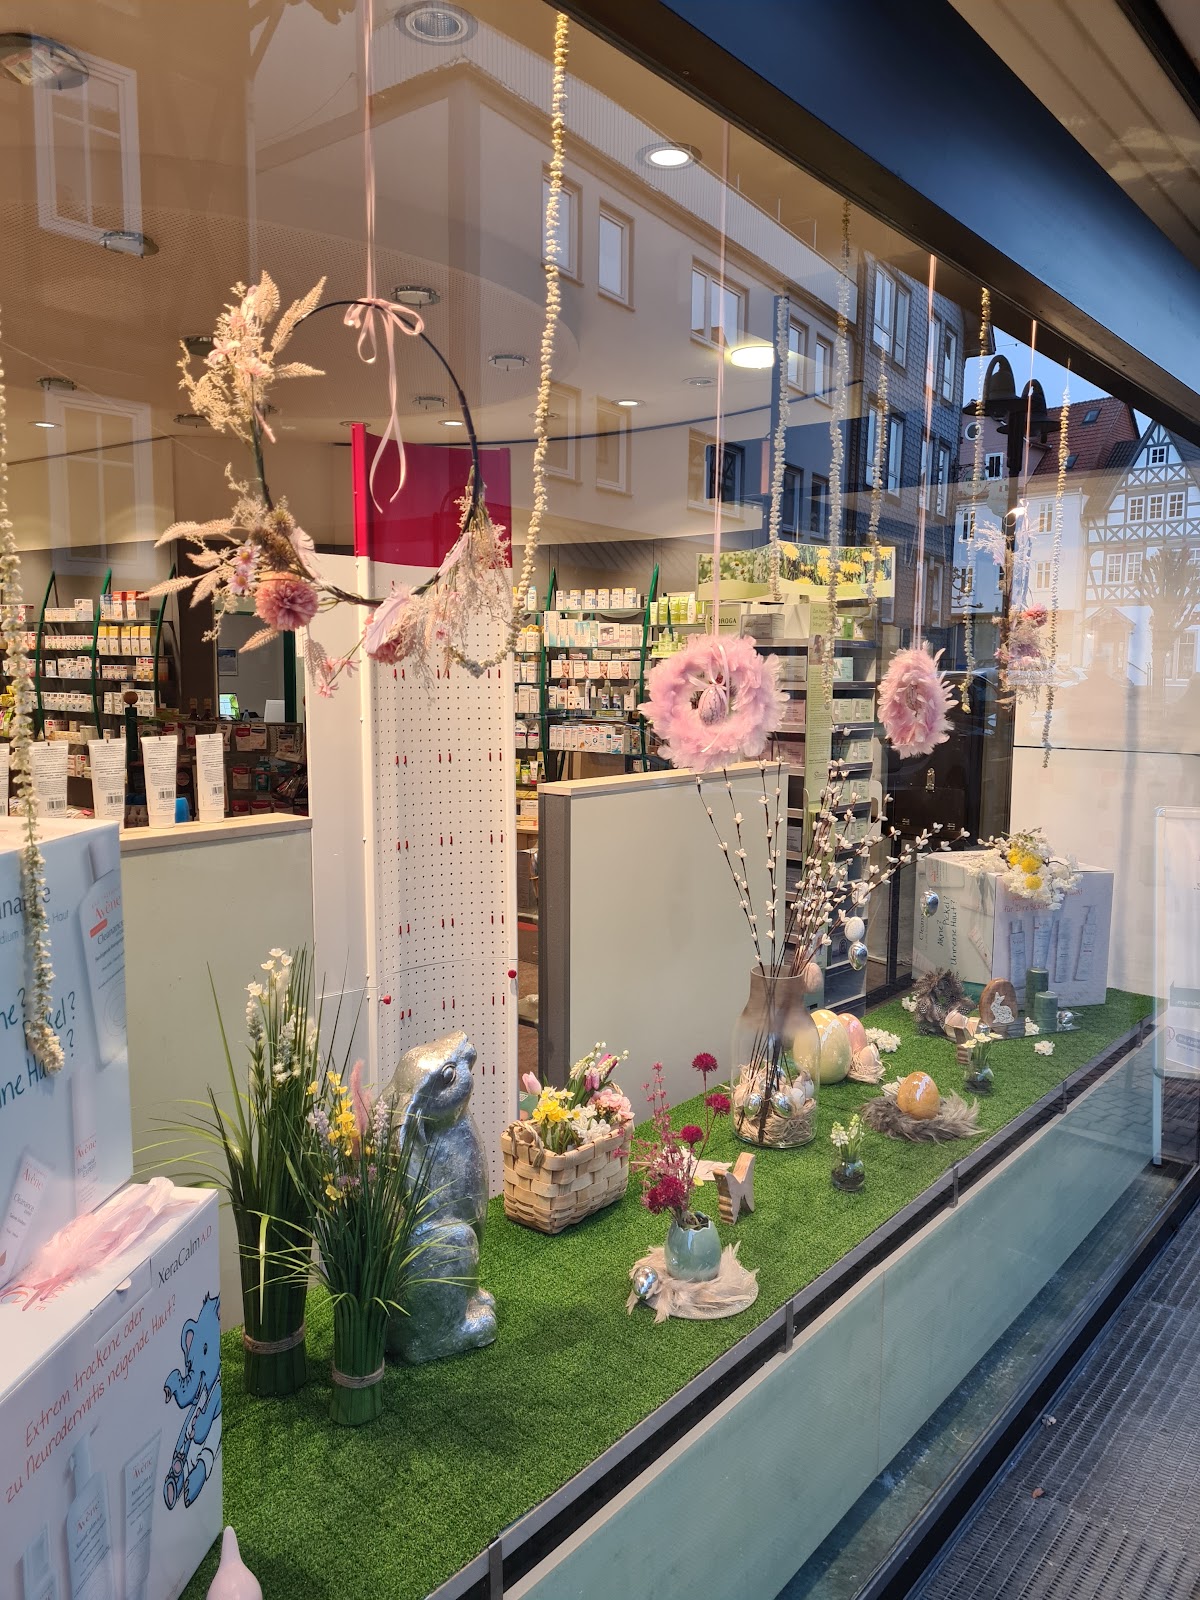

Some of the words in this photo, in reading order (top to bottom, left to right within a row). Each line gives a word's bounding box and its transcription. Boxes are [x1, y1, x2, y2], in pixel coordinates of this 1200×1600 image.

[709, 615, 737, 625] SROGA
[158, 1237, 200, 1289] XeraCalm
[5, 1477, 24, 1504] zu
[26, 1381, 105, 1481] Neurodermitis
[107, 1329, 150, 1380] neigende
[151, 1294, 176, 1336] Haut?
[25, 1389, 71, 1449] Extrem
[73, 1333, 121, 1391] trockene
[123, 1307, 145, 1339] oder
